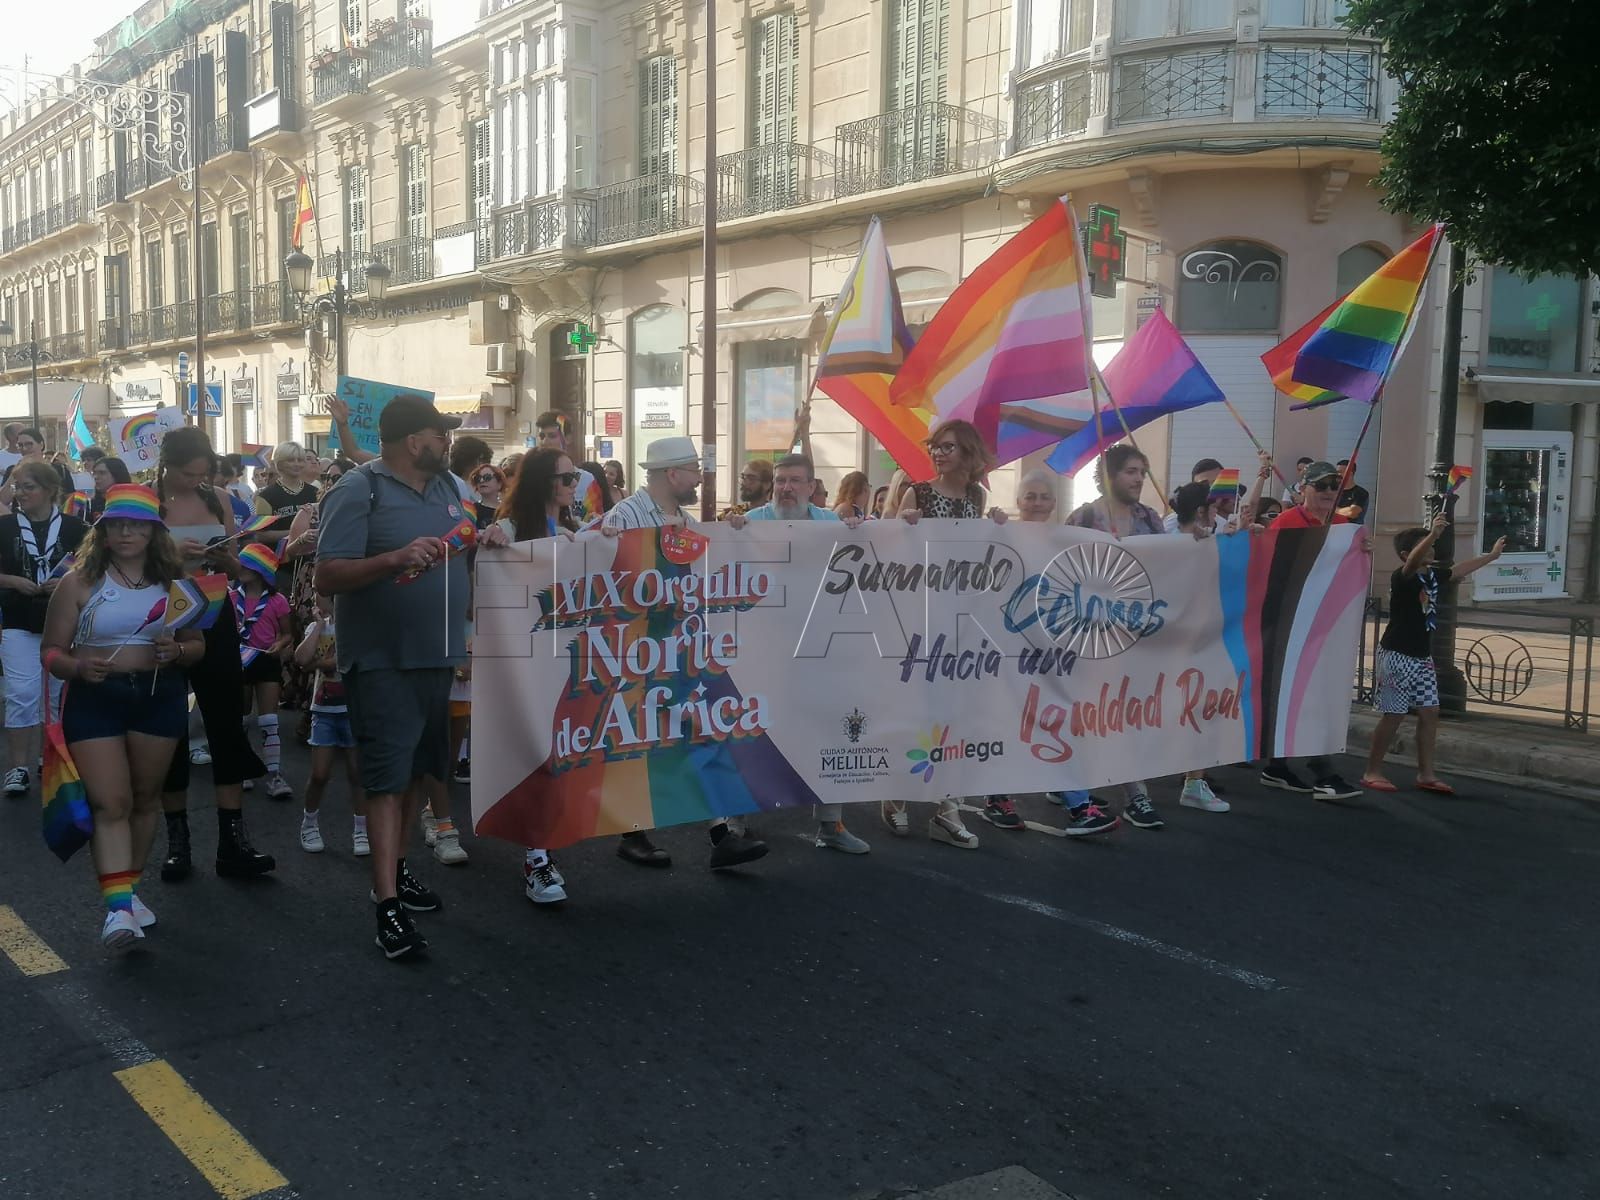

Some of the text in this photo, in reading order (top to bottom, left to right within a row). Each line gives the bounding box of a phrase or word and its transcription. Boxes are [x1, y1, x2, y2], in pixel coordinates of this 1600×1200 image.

[553, 563, 773, 615] XIX Orgullo
[825, 543, 1013, 595] Sumando
[1003, 575, 1168, 639] Colores
[583, 615, 739, 682] Norte
[900, 633, 1078, 684] Hacia una
[556, 681, 770, 759] de África
[1020, 668, 1246, 764] Igualdad Real
[822, 755, 889, 771] MELILLA
[929, 739, 1004, 763] amlega
